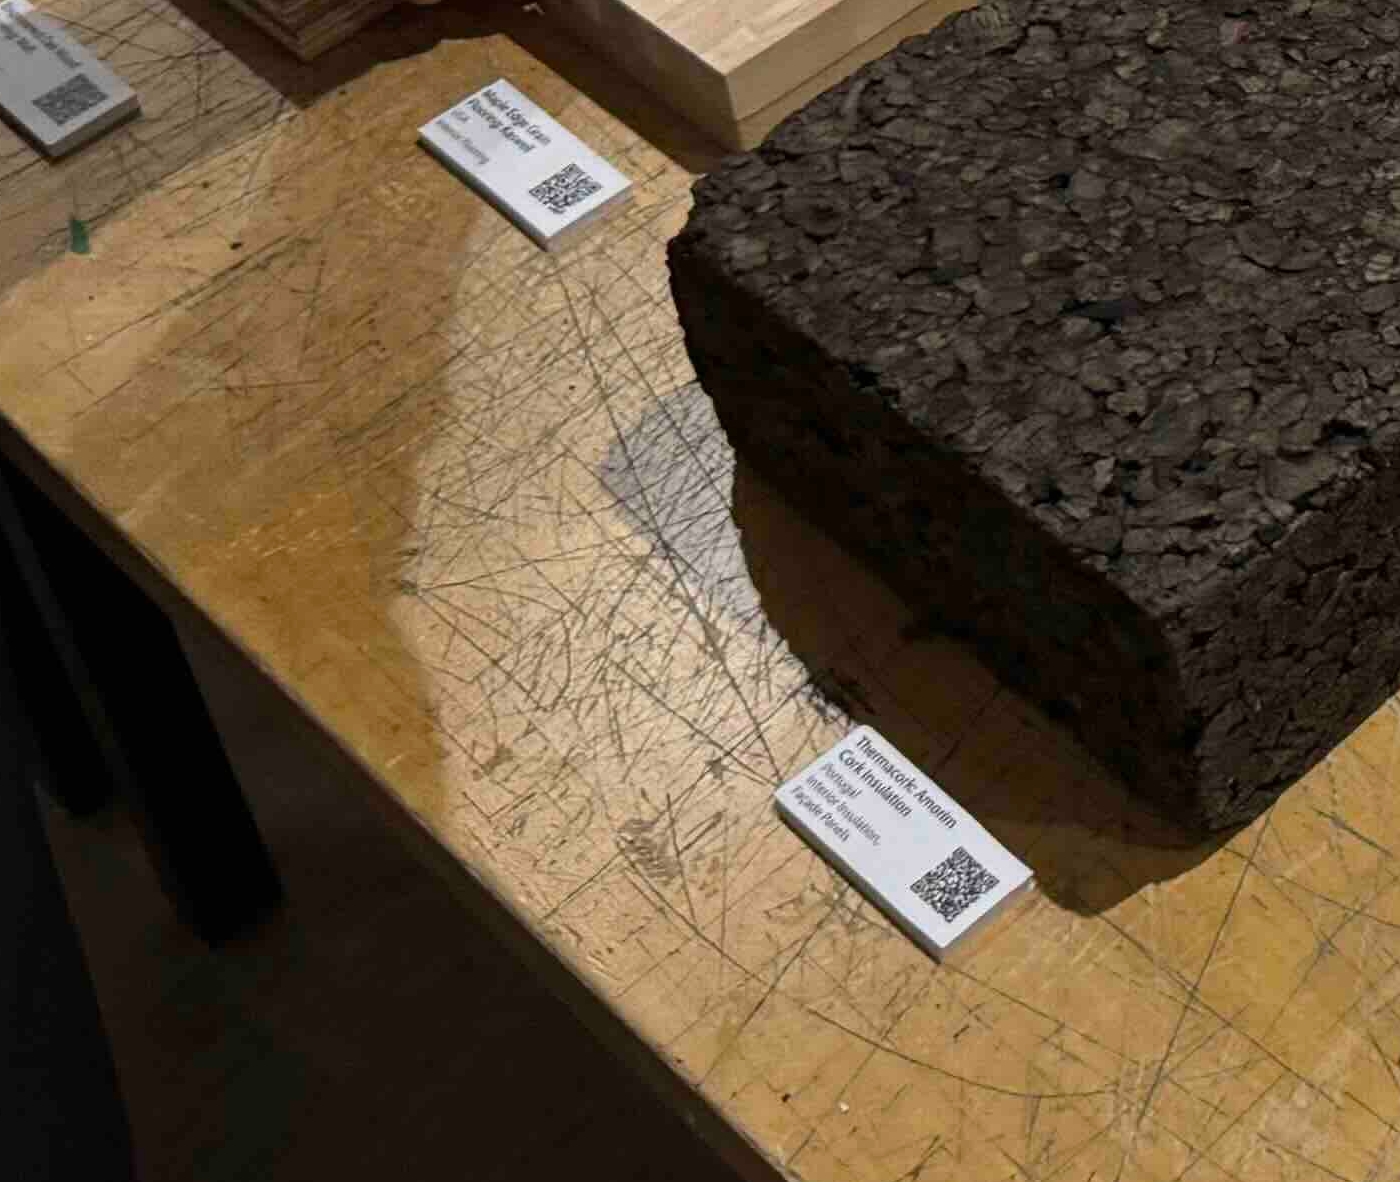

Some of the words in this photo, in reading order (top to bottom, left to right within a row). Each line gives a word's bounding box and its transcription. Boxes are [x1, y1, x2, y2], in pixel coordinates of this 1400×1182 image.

[503, 107, 530, 129] Edge
[526, 123, 553, 146] Grain
[807, 774, 840, 806] Interior
[819, 761, 861, 800] Portugal
[837, 747, 867, 775] Cork
[861, 768, 914, 817] Insulation
[820, 811, 851, 842] Panels
[913, 787, 959, 829] Amorim
